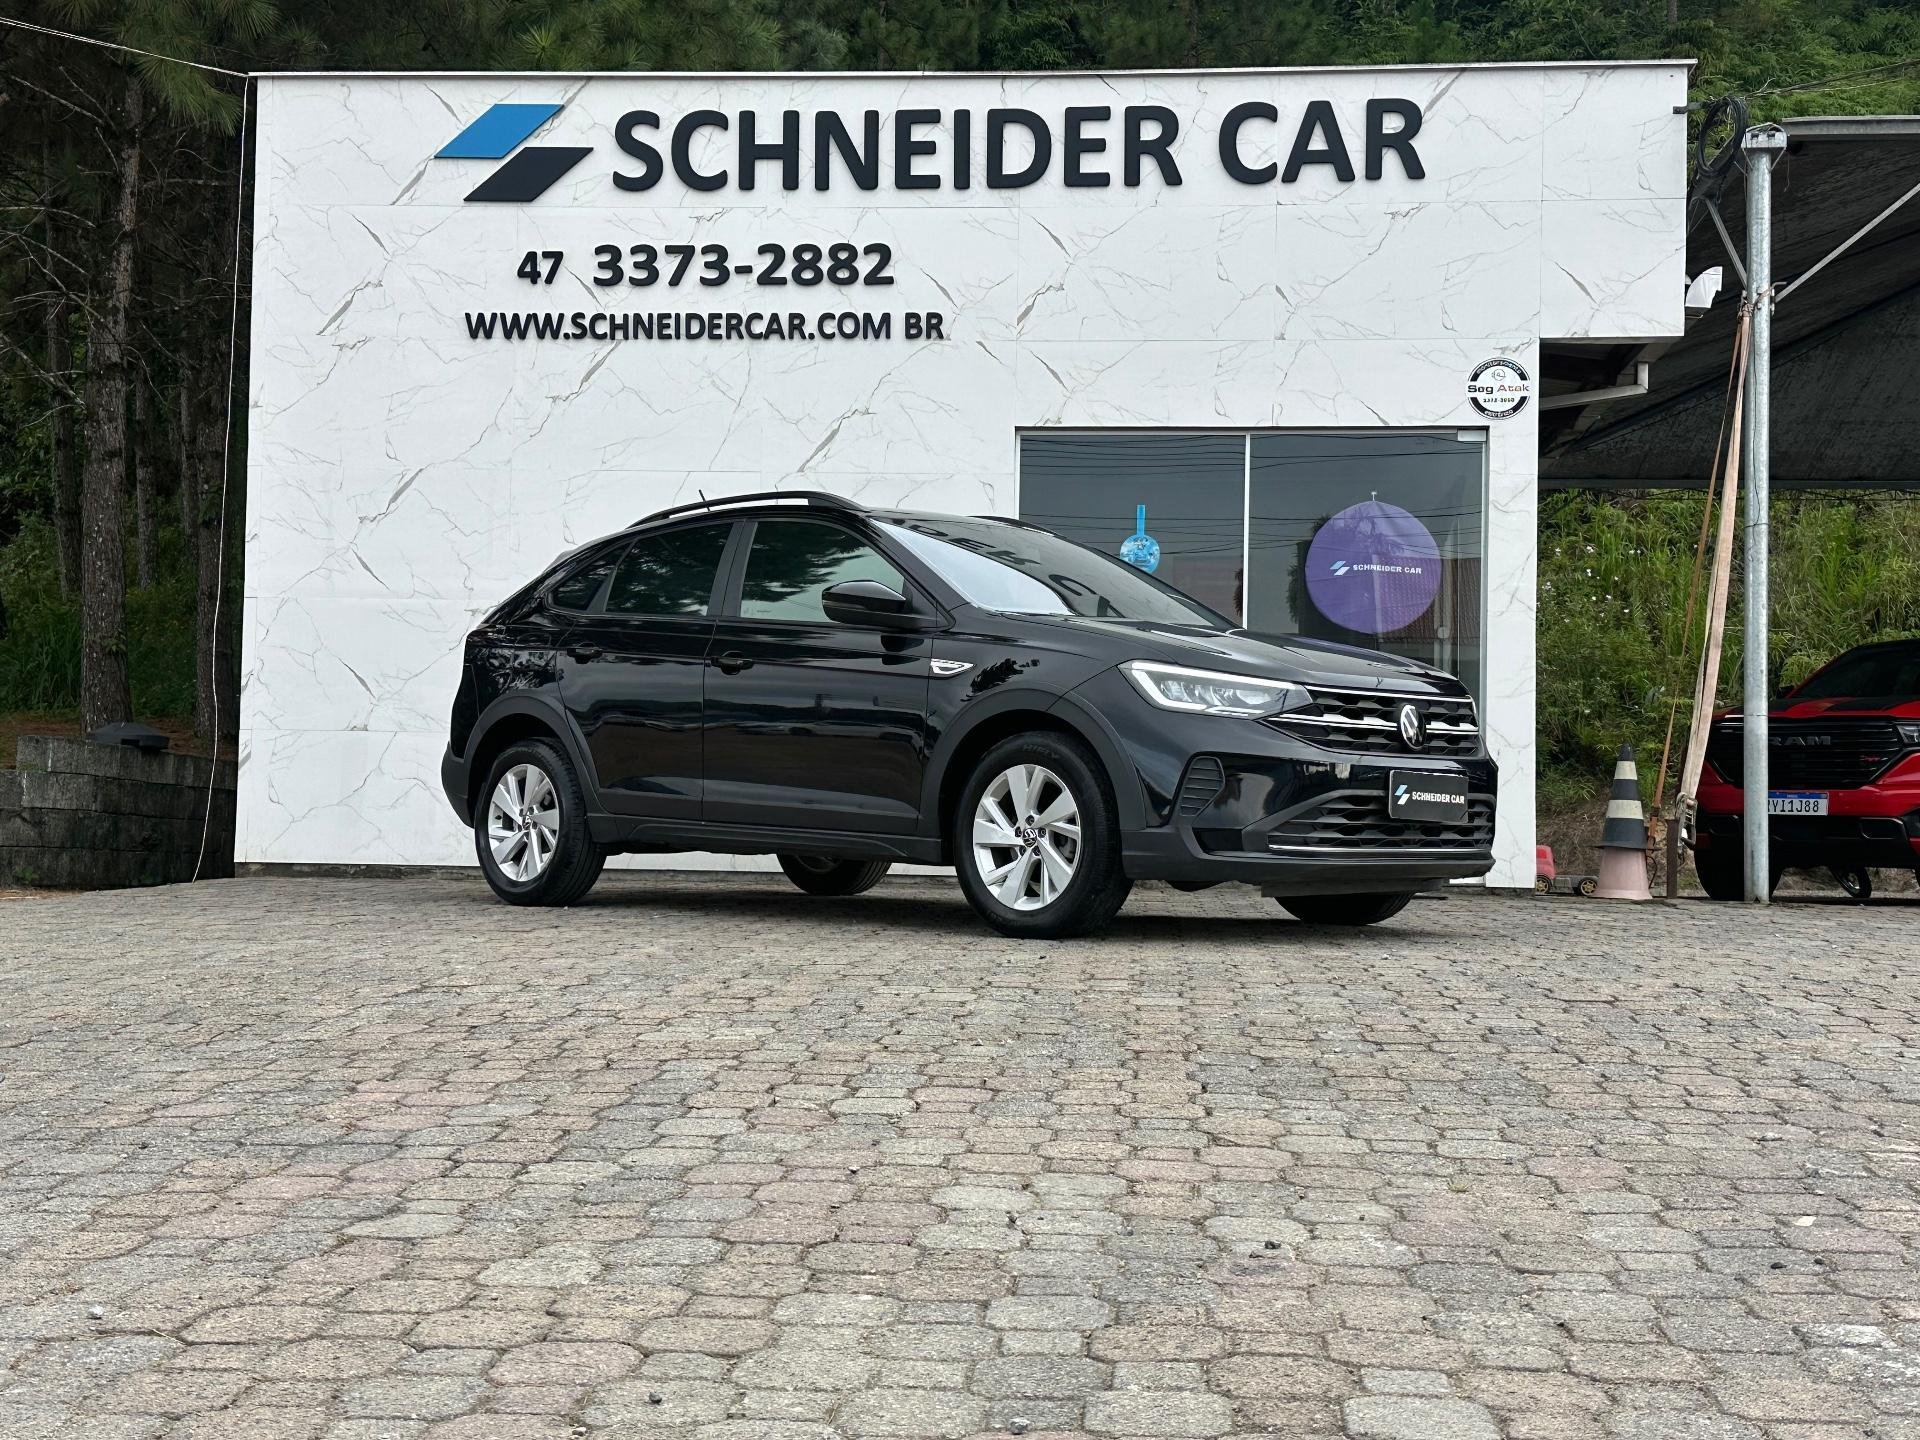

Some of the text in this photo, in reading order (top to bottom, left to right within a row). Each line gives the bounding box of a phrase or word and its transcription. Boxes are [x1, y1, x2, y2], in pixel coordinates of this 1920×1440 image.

[612, 98, 1426, 193] SCHNEIDER CAR
[517, 242, 895, 287] 47 3373-2882
[464, 310, 945, 341] WWW.SCHNEIDERCAR.COM BR
[1353, 564, 1422, 575] SCHNEIDER CAR
[1411, 790, 1465, 805] SCHNEIDER CAR
